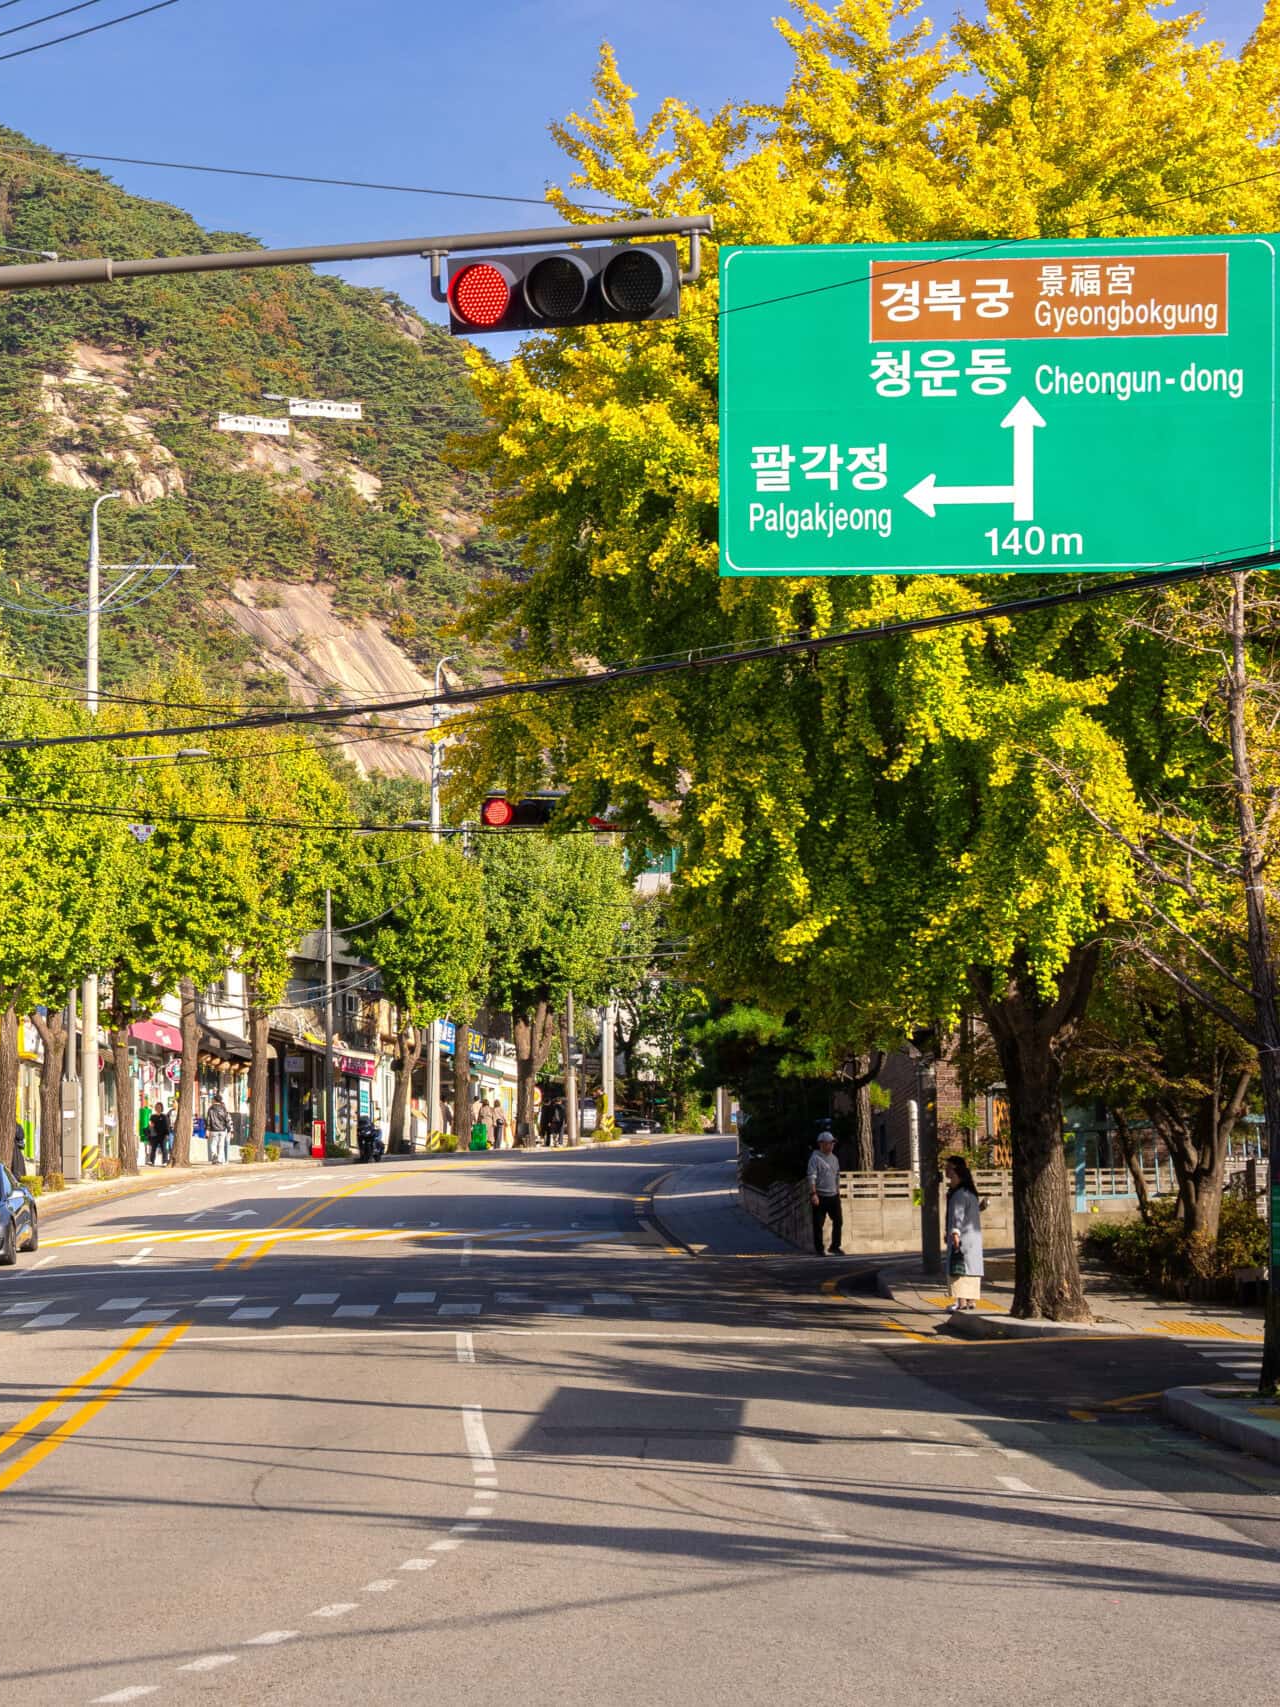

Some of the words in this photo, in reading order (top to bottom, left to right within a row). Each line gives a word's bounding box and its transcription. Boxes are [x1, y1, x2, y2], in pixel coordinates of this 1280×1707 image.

[1037, 264, 1135, 297] 景福宮
[880, 278, 1014, 322] 경복궁
[1035, 300, 1218, 333] Gyeongbokgung
[869, 348, 1012, 397] 청운동
[1035, 363, 1243, 401] Cheongun-dong
[750, 443, 887, 492] 팔각정
[749, 502, 892, 539] Palgakjeong
